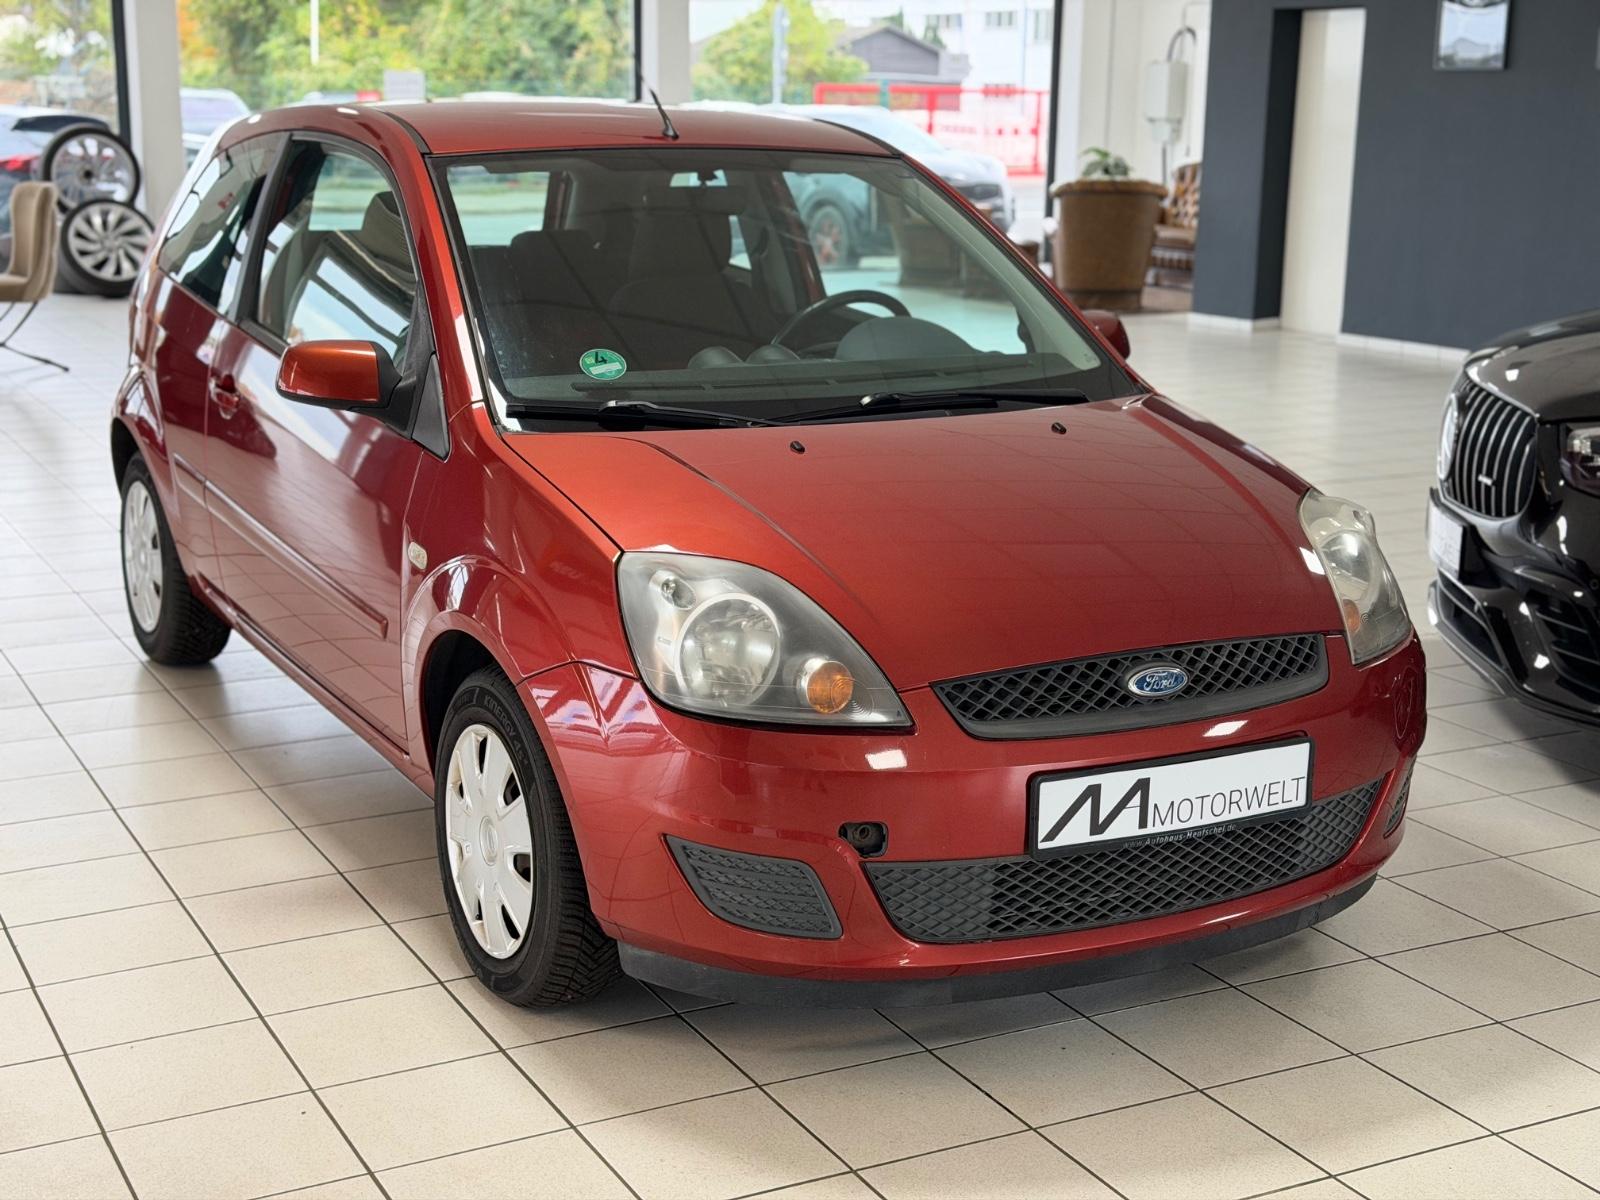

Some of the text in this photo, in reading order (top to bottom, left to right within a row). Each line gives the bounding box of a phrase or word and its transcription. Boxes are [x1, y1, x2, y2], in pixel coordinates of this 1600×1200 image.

[594, 351, 608, 364] 4
[1143, 671, 1177, 691] Ford
[1152, 776, 1306, 828] MOTORWELT
